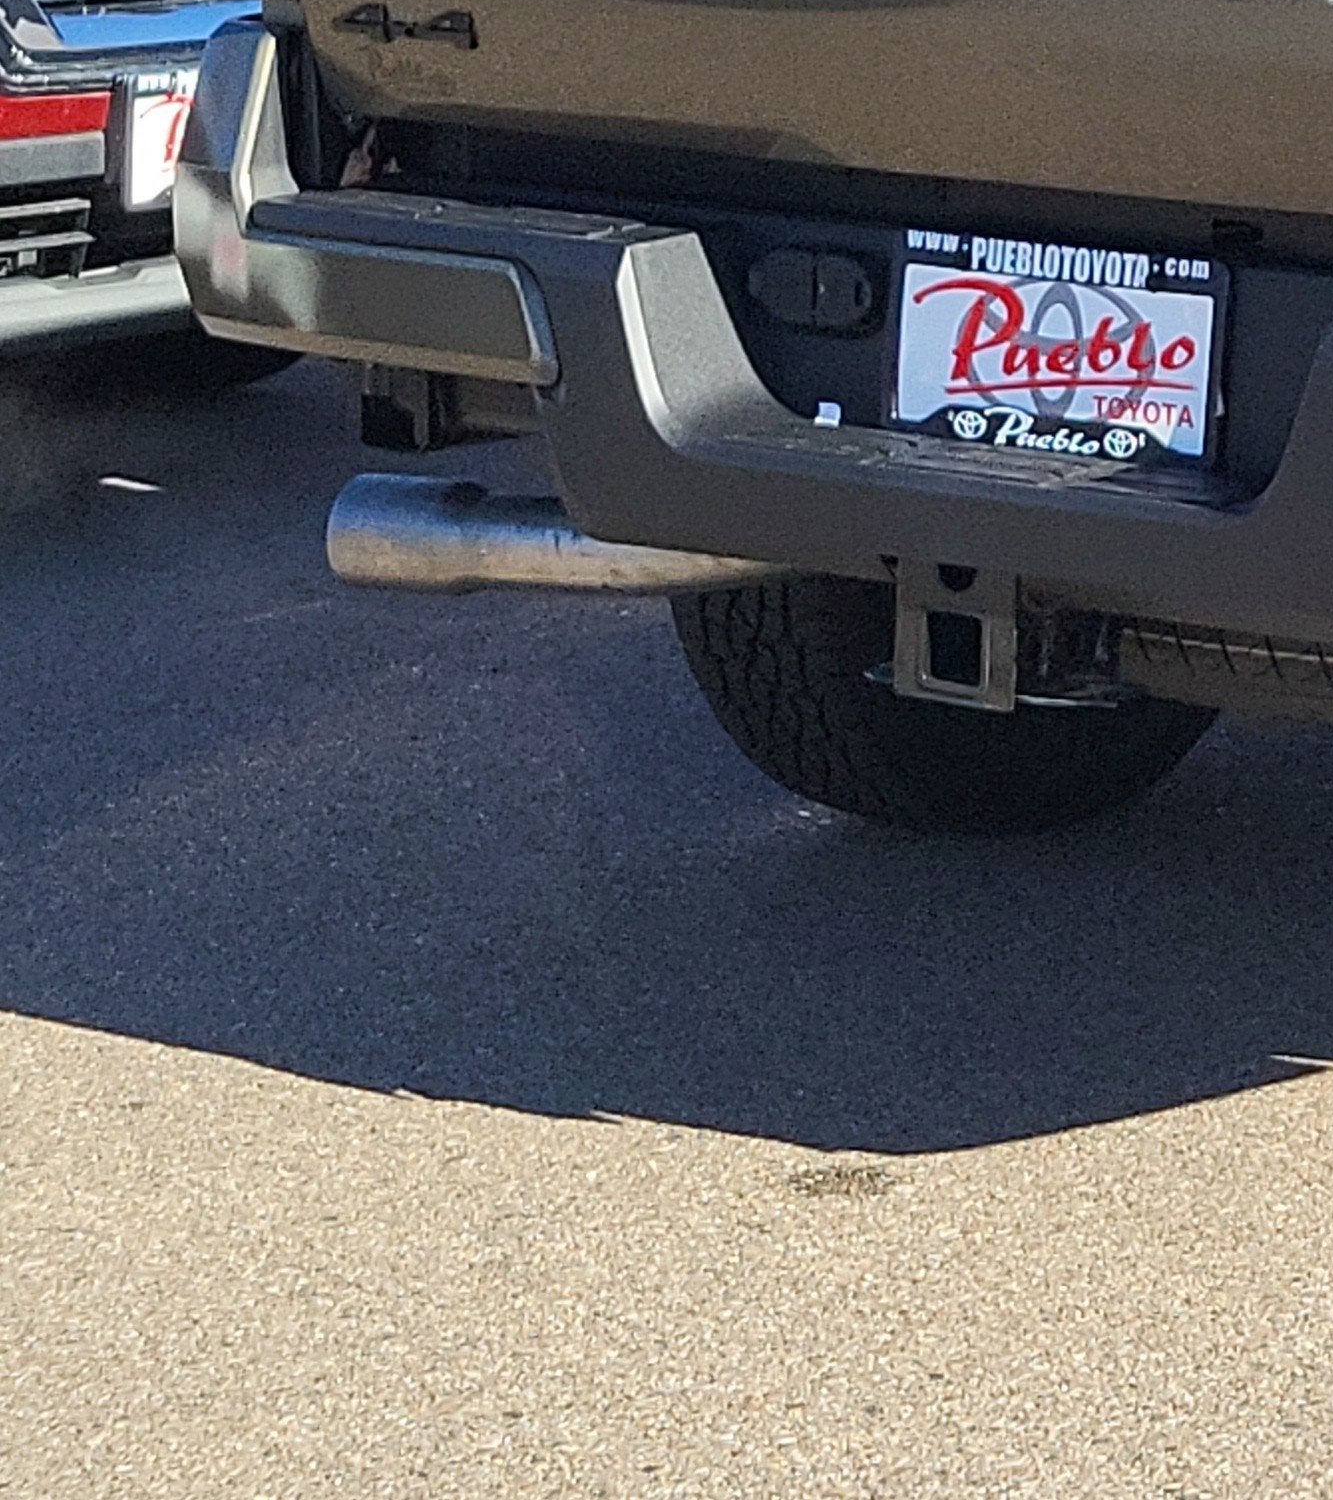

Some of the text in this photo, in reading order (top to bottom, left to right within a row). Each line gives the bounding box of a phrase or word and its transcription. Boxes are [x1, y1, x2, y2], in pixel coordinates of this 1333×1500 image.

[913, 276, 1197, 381] Pueblo
[984, 406, 1101, 456] Pueblo
[1092, 395, 1195, 429] TOYOTA
